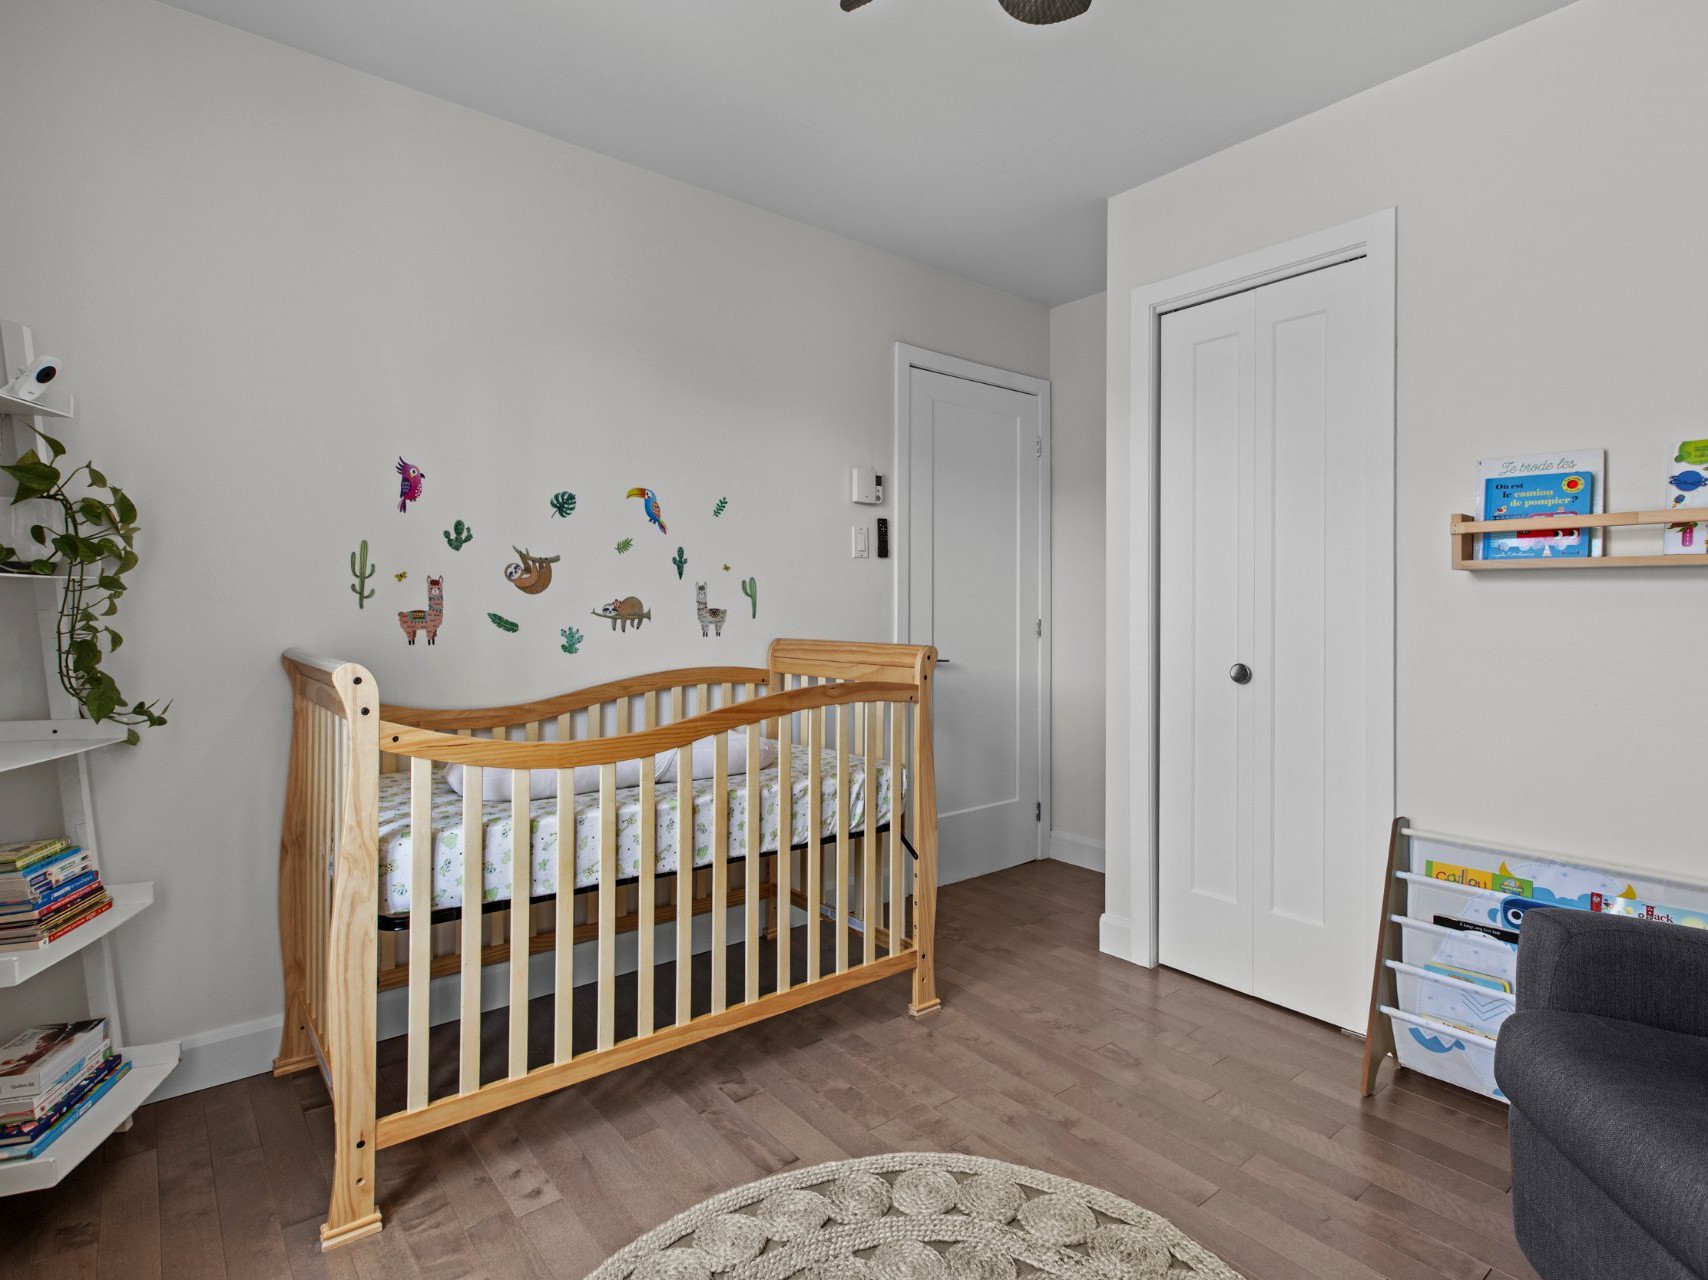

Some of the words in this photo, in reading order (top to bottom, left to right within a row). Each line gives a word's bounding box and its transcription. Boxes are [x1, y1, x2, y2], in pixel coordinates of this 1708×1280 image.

[1498, 461, 1517, 476] Je
[1519, 460, 1554, 473] brode
[1556, 458, 1578, 469] les
[1514, 488, 1554, 498] camion
[1509, 498, 1521, 507] de
